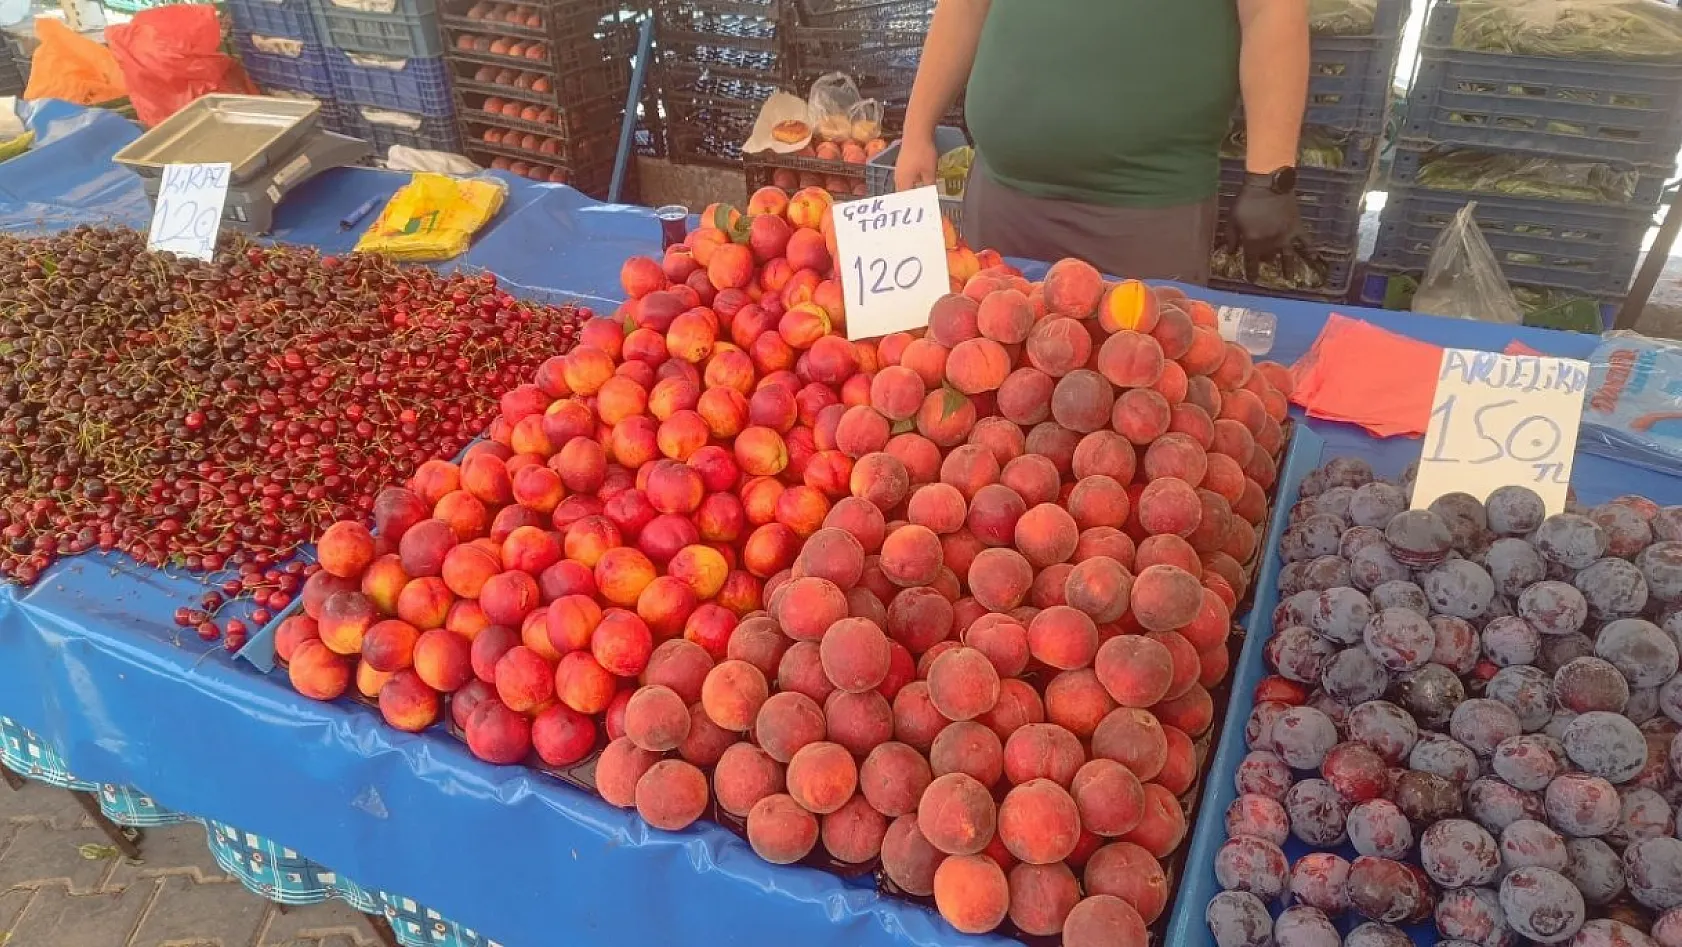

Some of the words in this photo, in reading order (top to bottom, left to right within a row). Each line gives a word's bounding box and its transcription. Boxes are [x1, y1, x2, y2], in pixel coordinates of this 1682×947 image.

[153, 199, 218, 243] 120
[858, 207, 924, 232] TATLI
[854, 255, 923, 305] 120
[1423, 394, 1562, 464] 150
[1531, 462, 1569, 483] TL
